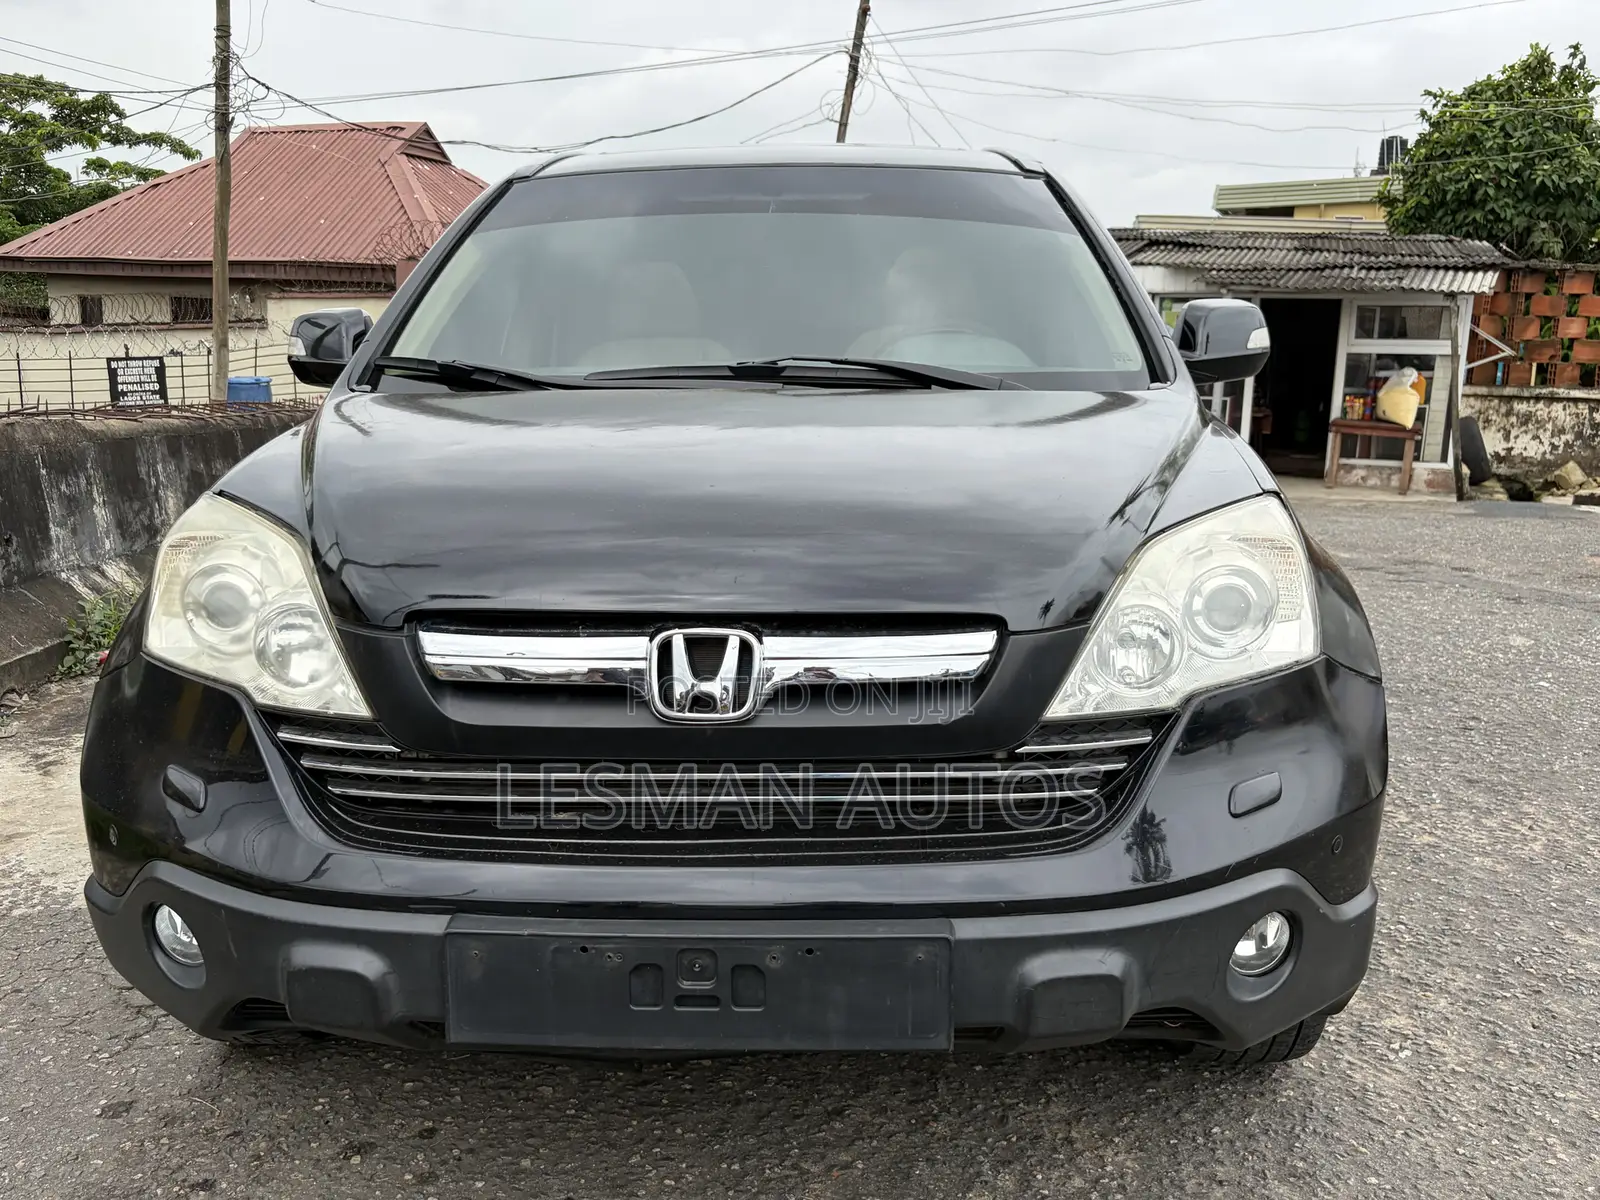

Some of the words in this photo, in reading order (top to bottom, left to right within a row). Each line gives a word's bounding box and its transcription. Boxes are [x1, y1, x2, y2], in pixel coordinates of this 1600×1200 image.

[111, 360, 117, 368] DO
[118, 360, 127, 368] NOT
[143, 359, 160, 367] REFUSE
[125, 367, 143, 375] EXCRETE
[117, 375, 140, 383] OFFENDER
[151, 374, 157, 382] BE
[118, 383, 160, 392] PENALISED
